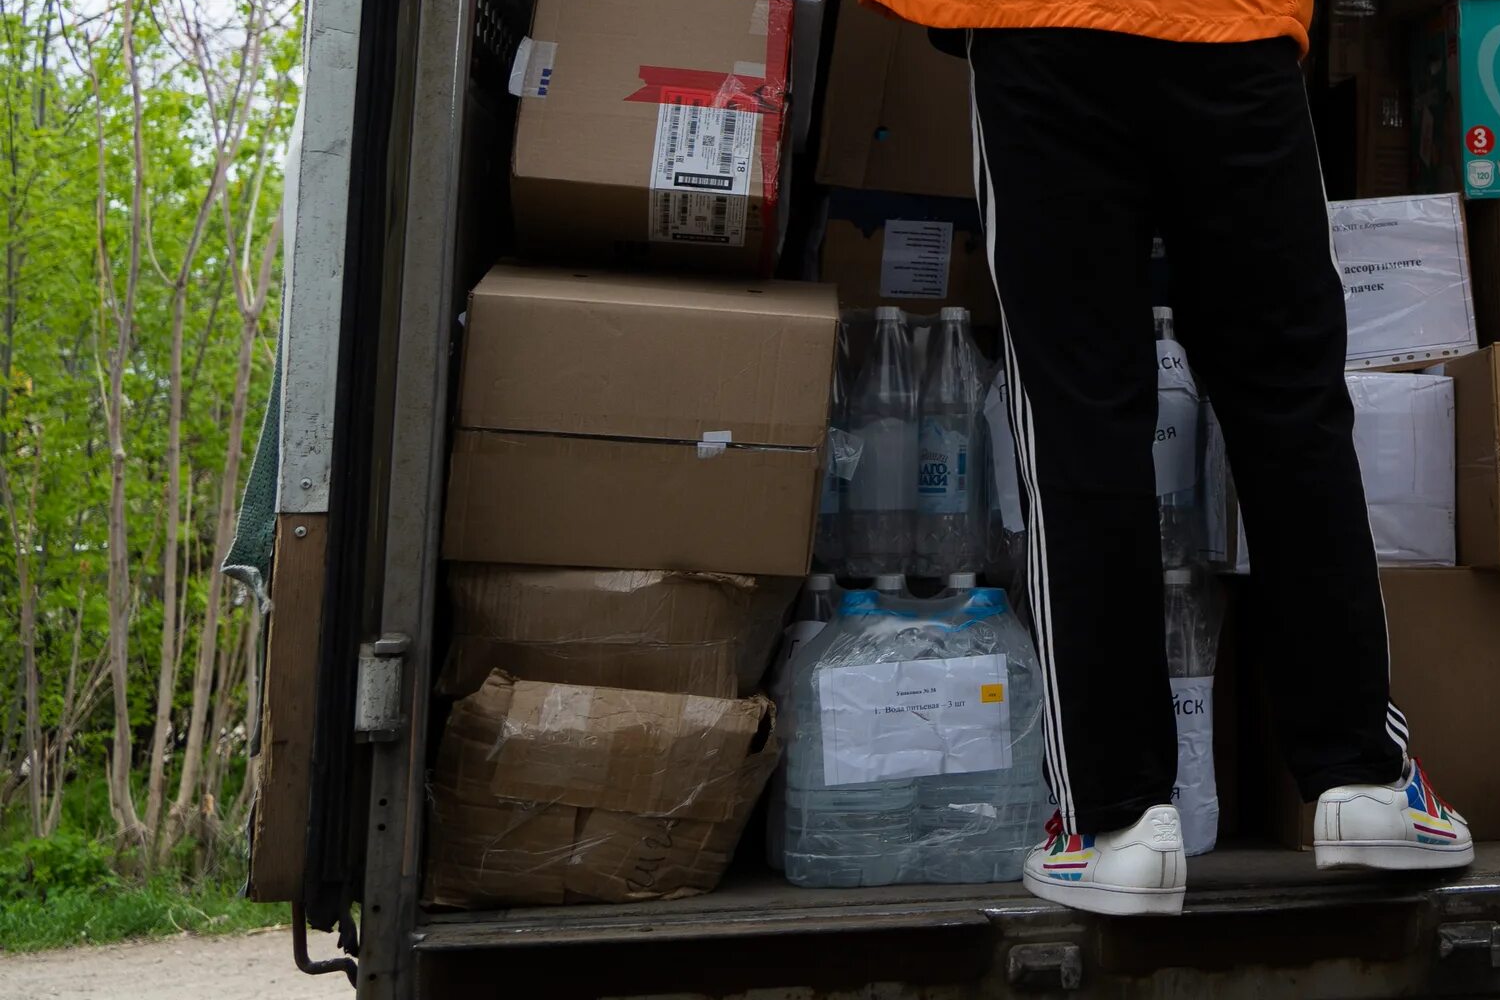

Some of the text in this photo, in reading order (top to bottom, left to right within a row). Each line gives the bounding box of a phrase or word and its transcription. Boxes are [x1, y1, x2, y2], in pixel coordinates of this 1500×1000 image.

[1473, 128, 1487, 148] 3
[737, 161, 746, 173] 18
[1476, 171, 1490, 180] 120
[1344, 258, 1423, 274] ассортименте
[1350, 282, 1385, 294] пачек
[885, 705, 905, 713] Вода
[906, 701, 940, 712] питьевая
[954, 700, 965, 708] шт
